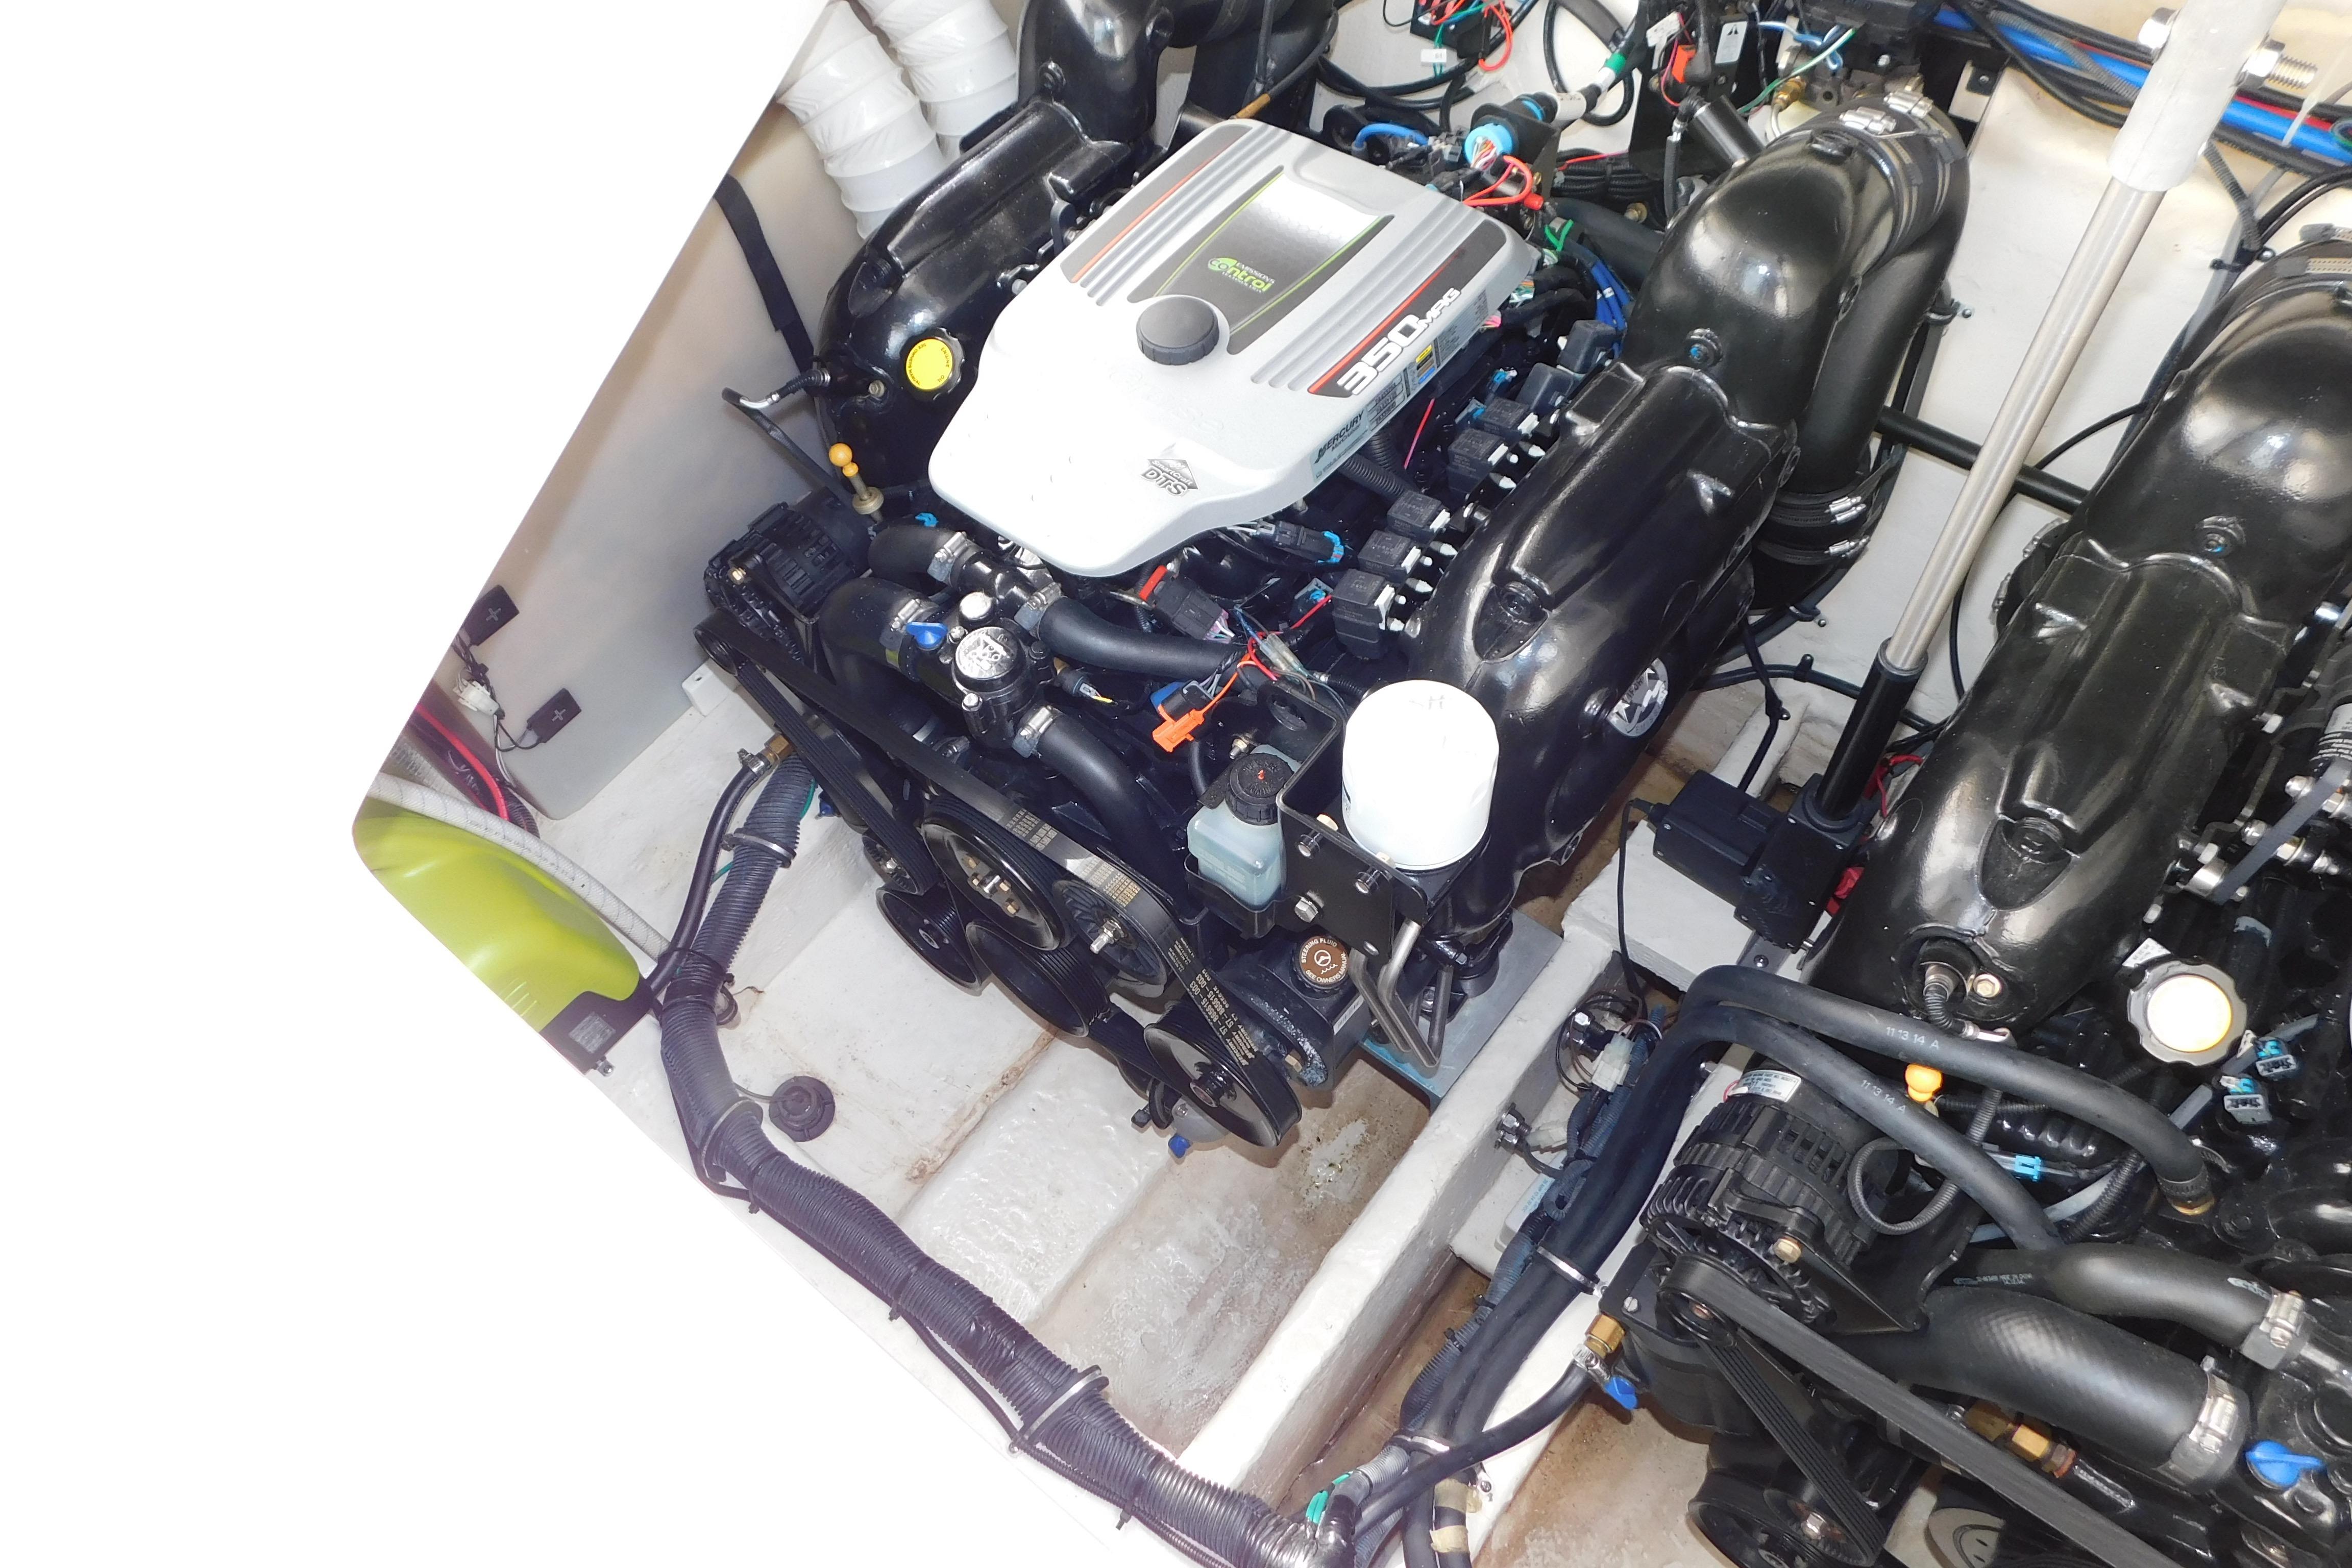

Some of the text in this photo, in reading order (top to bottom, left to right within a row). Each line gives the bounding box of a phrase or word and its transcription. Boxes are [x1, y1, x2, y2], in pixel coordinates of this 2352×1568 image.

[1236, 262, 1276, 284] EMISSIONS
[1337, 314, 1423, 396] 350
[1417, 287, 1461, 328] MAG
[1314, 410, 1365, 464] MERCURY
[1140, 465, 1188, 496] DTS
[1301, 938, 1337, 963] STEERING FLUID
[1306, 951, 1347, 984] SEE OWNERS MANUAL
[1226, 1038, 1249, 1066] MERCURY
[1232, 1032, 1255, 1059] MERCURY
[1886, 1026, 1940, 1050] 11 13 14 A
[1861, 1080, 1871, 1089] 11
[1883, 1094, 1895, 1105] 14
[1897, 1105, 1906, 1114] A
